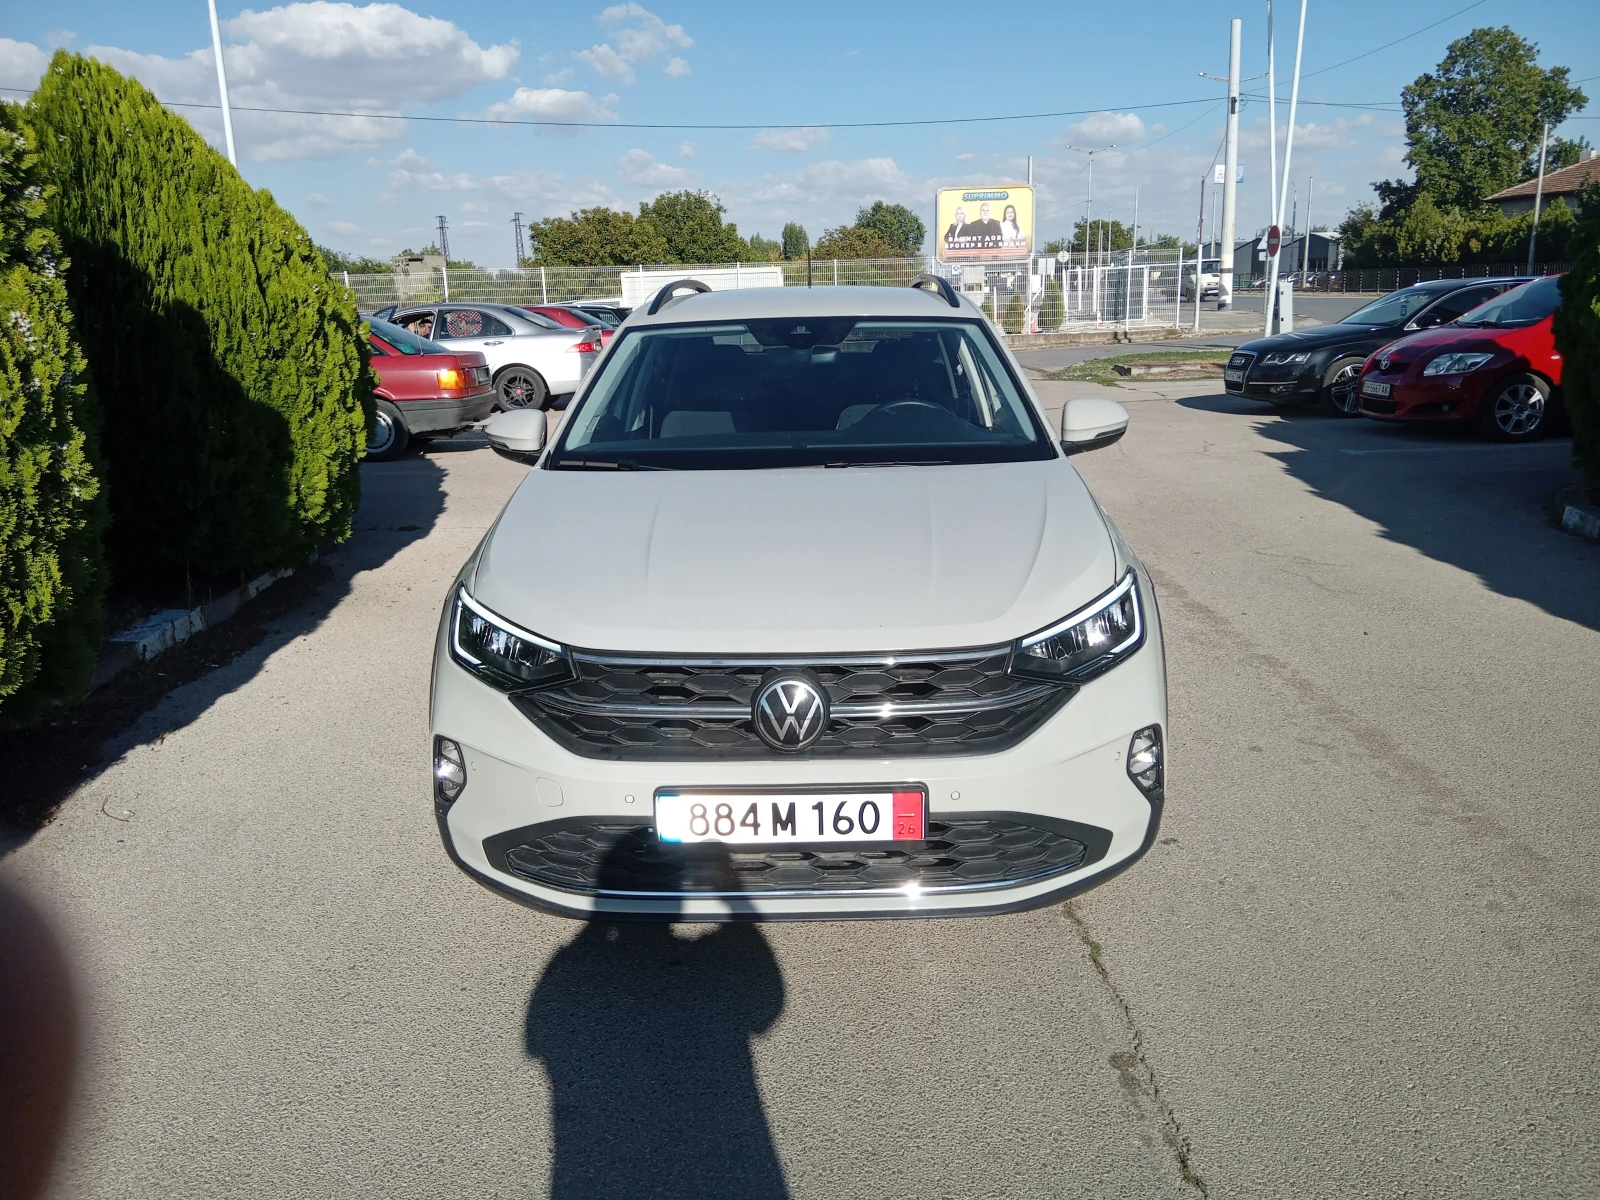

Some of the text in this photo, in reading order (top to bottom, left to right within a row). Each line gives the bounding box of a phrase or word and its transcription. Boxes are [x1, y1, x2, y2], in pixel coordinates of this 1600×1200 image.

[963, 191, 1008, 201] SUPRIMMO
[689, 800, 880, 837] 884 M 160
[897, 822, 915, 835] 26
